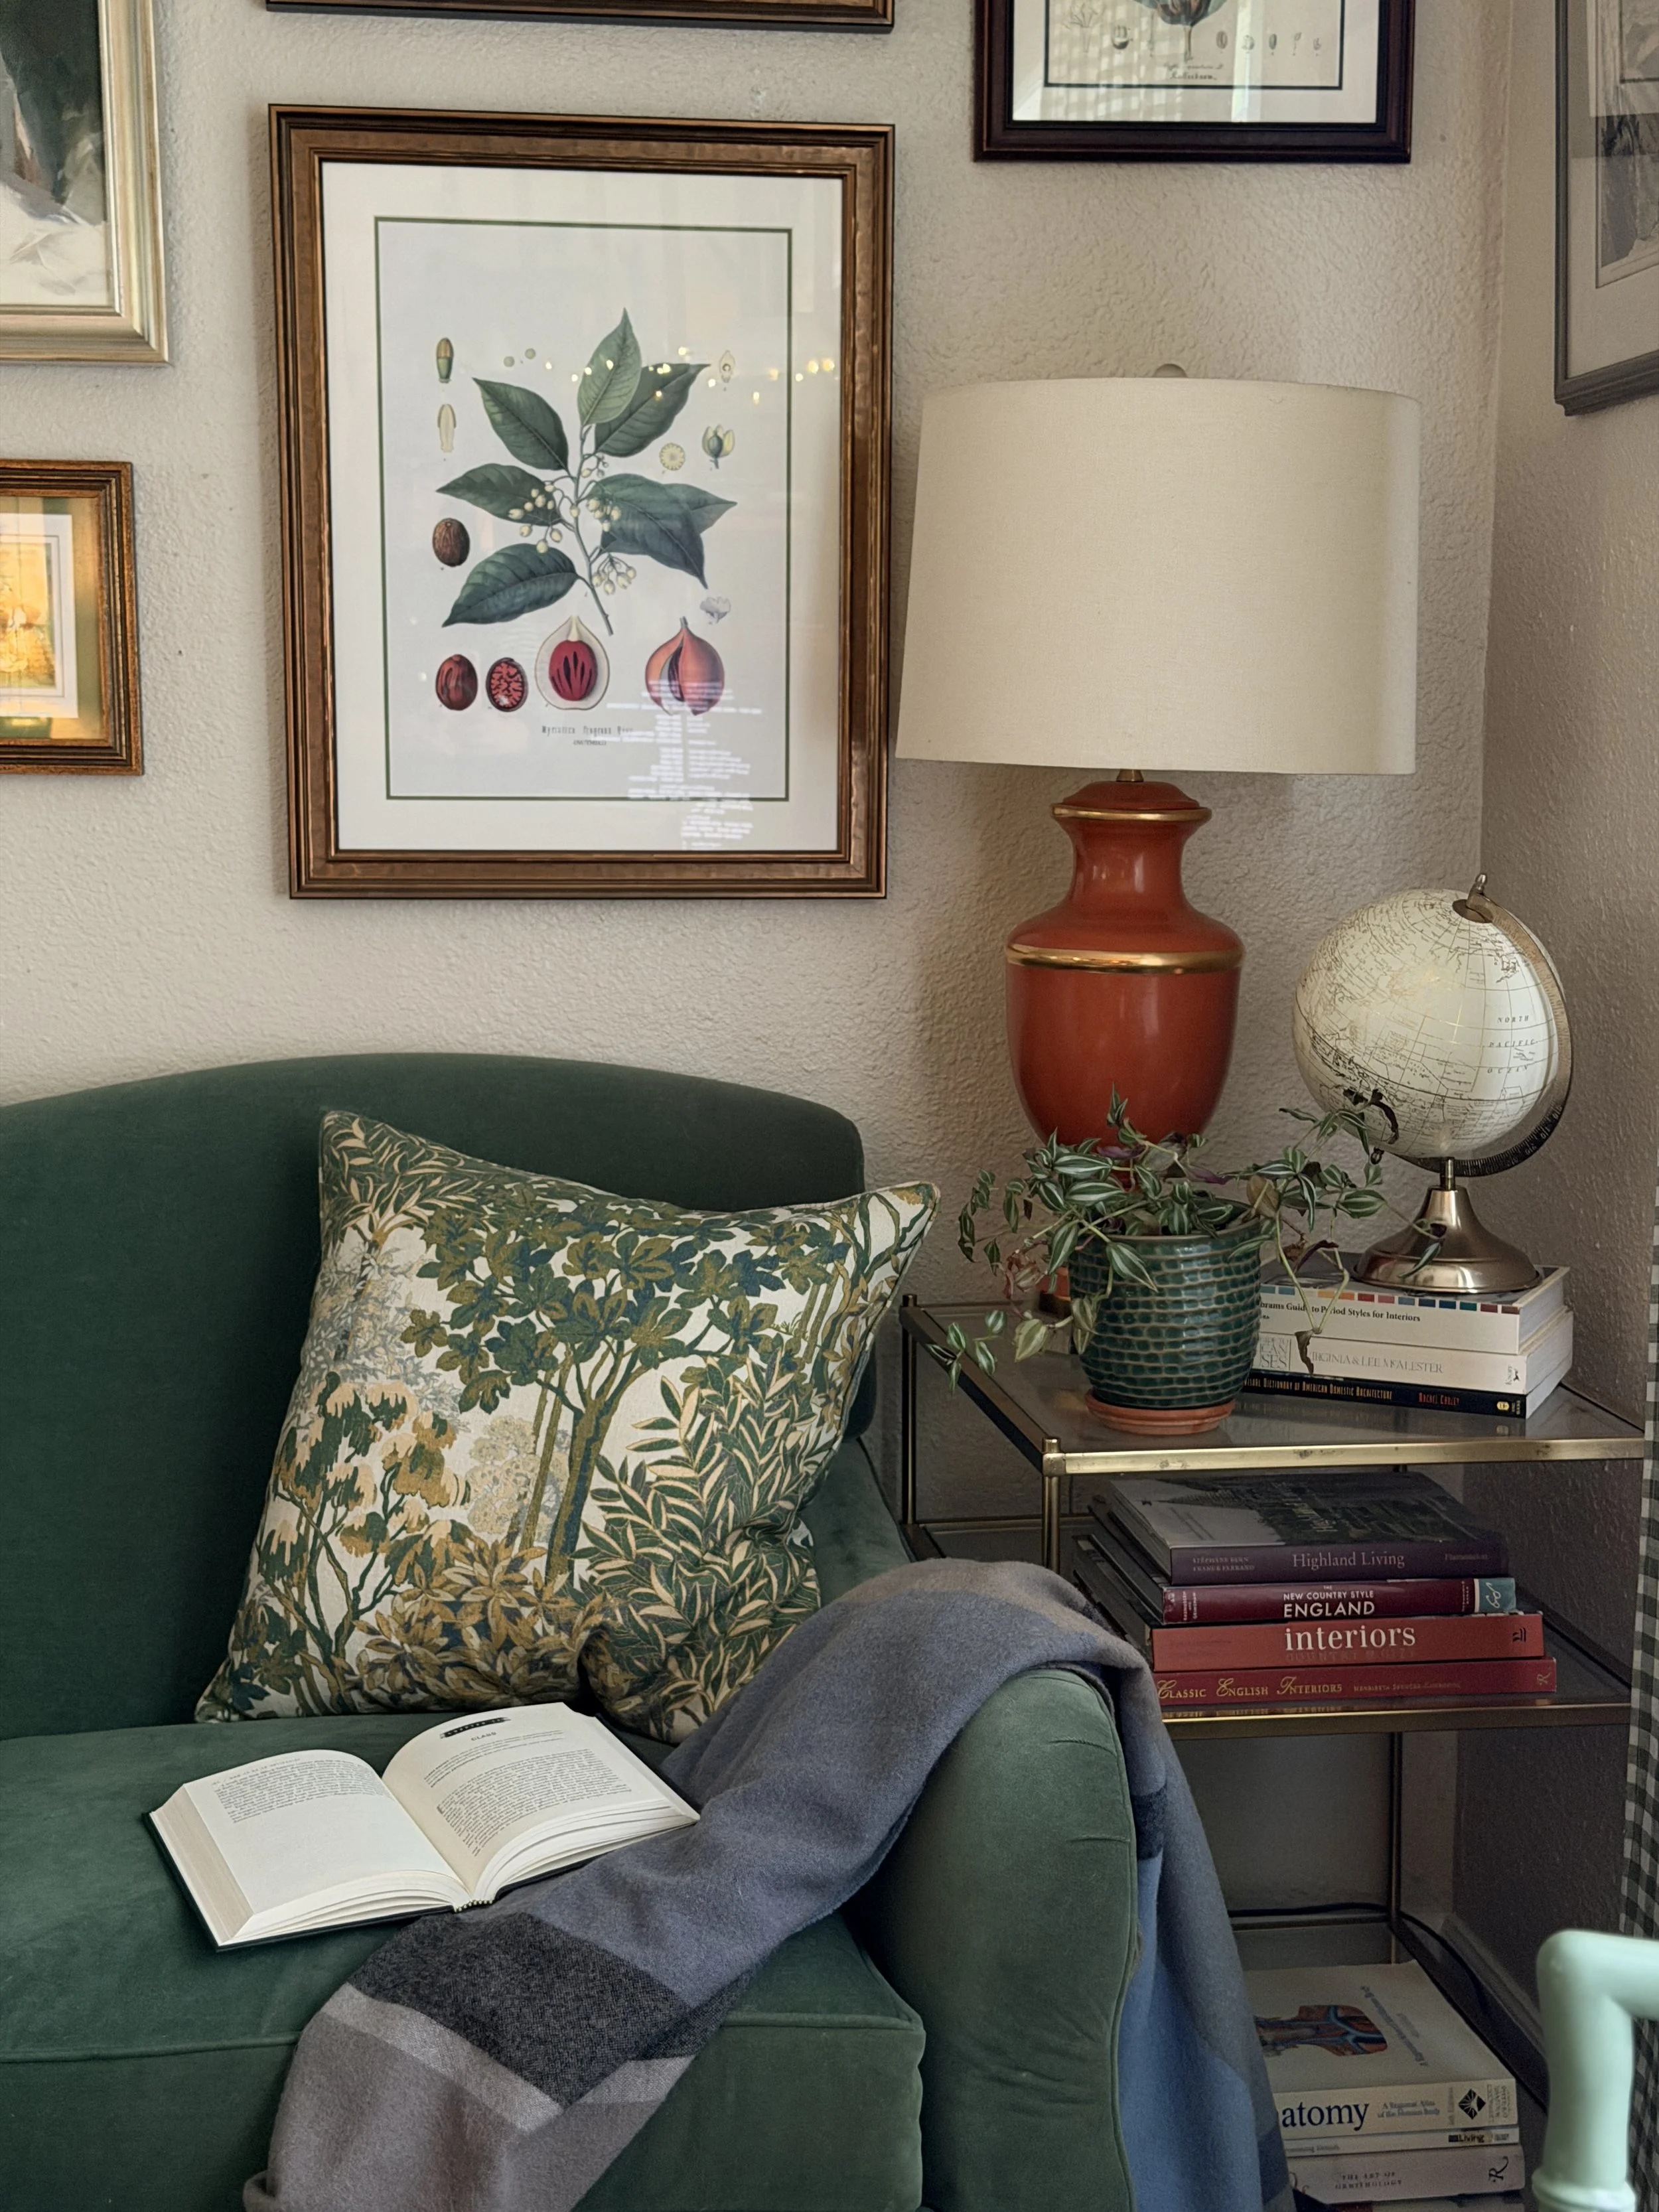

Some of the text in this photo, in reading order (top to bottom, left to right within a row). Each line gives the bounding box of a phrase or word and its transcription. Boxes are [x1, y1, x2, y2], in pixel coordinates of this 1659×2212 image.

[1488, 1039, 1535, 1048] PACIFIC
[1260, 1301, 1284, 1311] brams
[1286, 1303, 1307, 1311] Guid
[1321, 1306, 1346, 1315] Piod
[1348, 1308, 1370, 1318] Styles
[1372, 1310, 1384, 1319] for
[1386, 1312, 1421, 1322] Interiors
[1310, 1351, 1352, 1365] IRGINIA
[1361, 1357, 1380, 1368] LEE
[1292, 1550, 1406, 1570] Highland Living
[1283, 1590, 1374, 1601] NEW COUNTRY STYLE
[1283, 1601, 1375, 1618] ENGLAND
[1285, 1625, 1415, 1651] interiors
[1281, 2100, 1370, 2131] atomy
